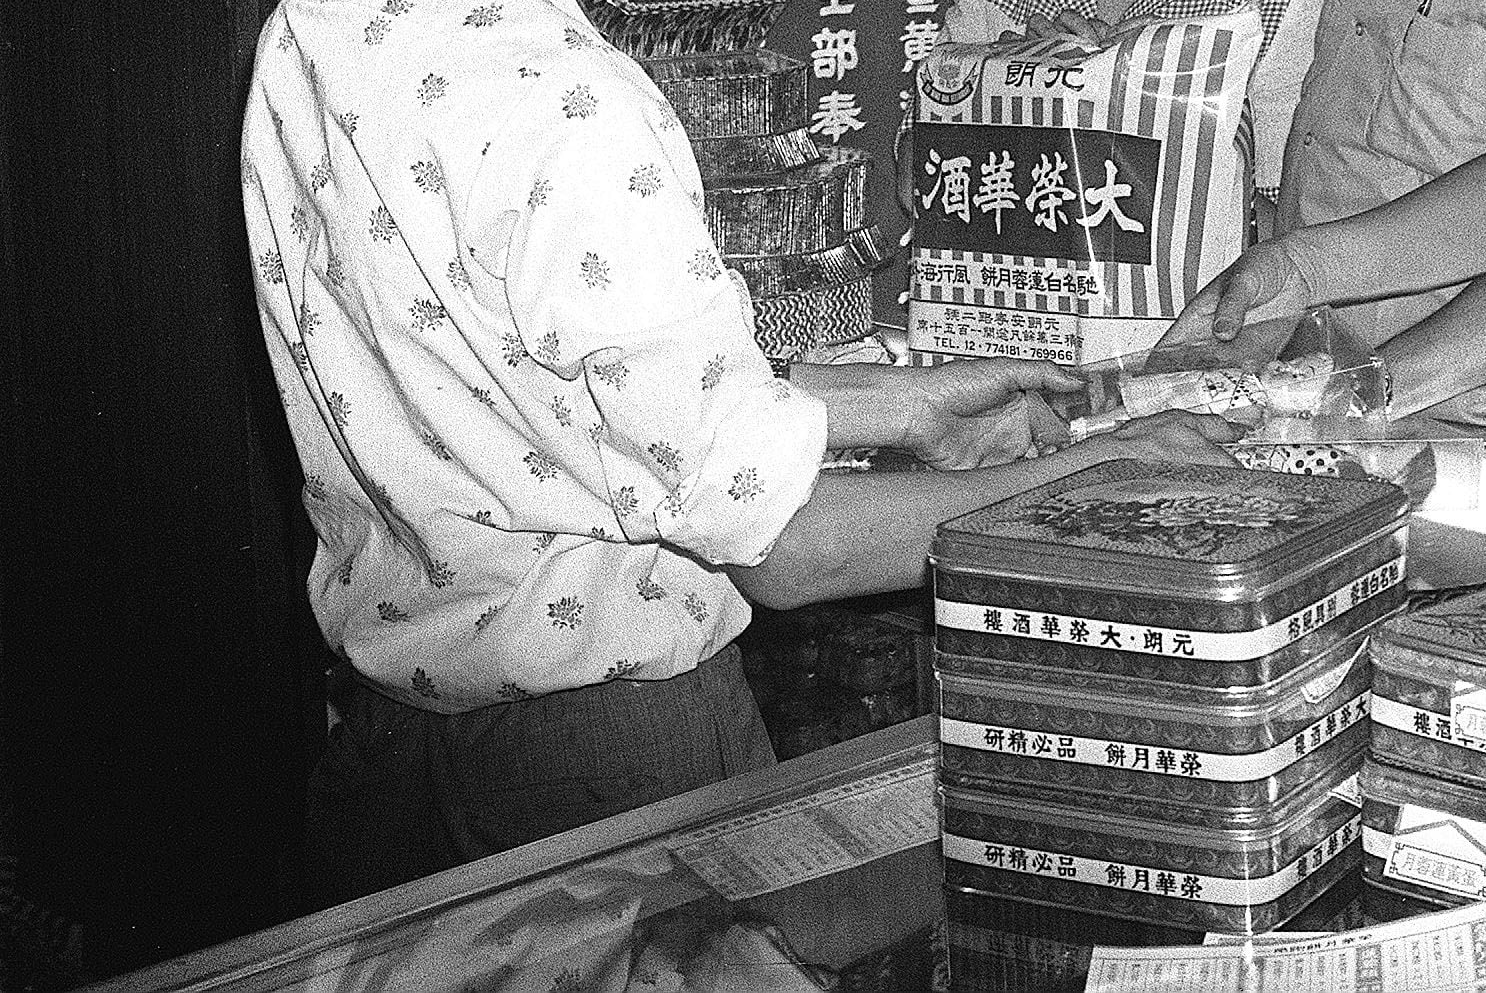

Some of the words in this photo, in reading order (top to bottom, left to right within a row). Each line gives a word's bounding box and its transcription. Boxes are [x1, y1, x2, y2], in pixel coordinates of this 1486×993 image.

[912, 148, 1146, 235] 大榮華酒
[933, 335, 961, 350] TEL.
